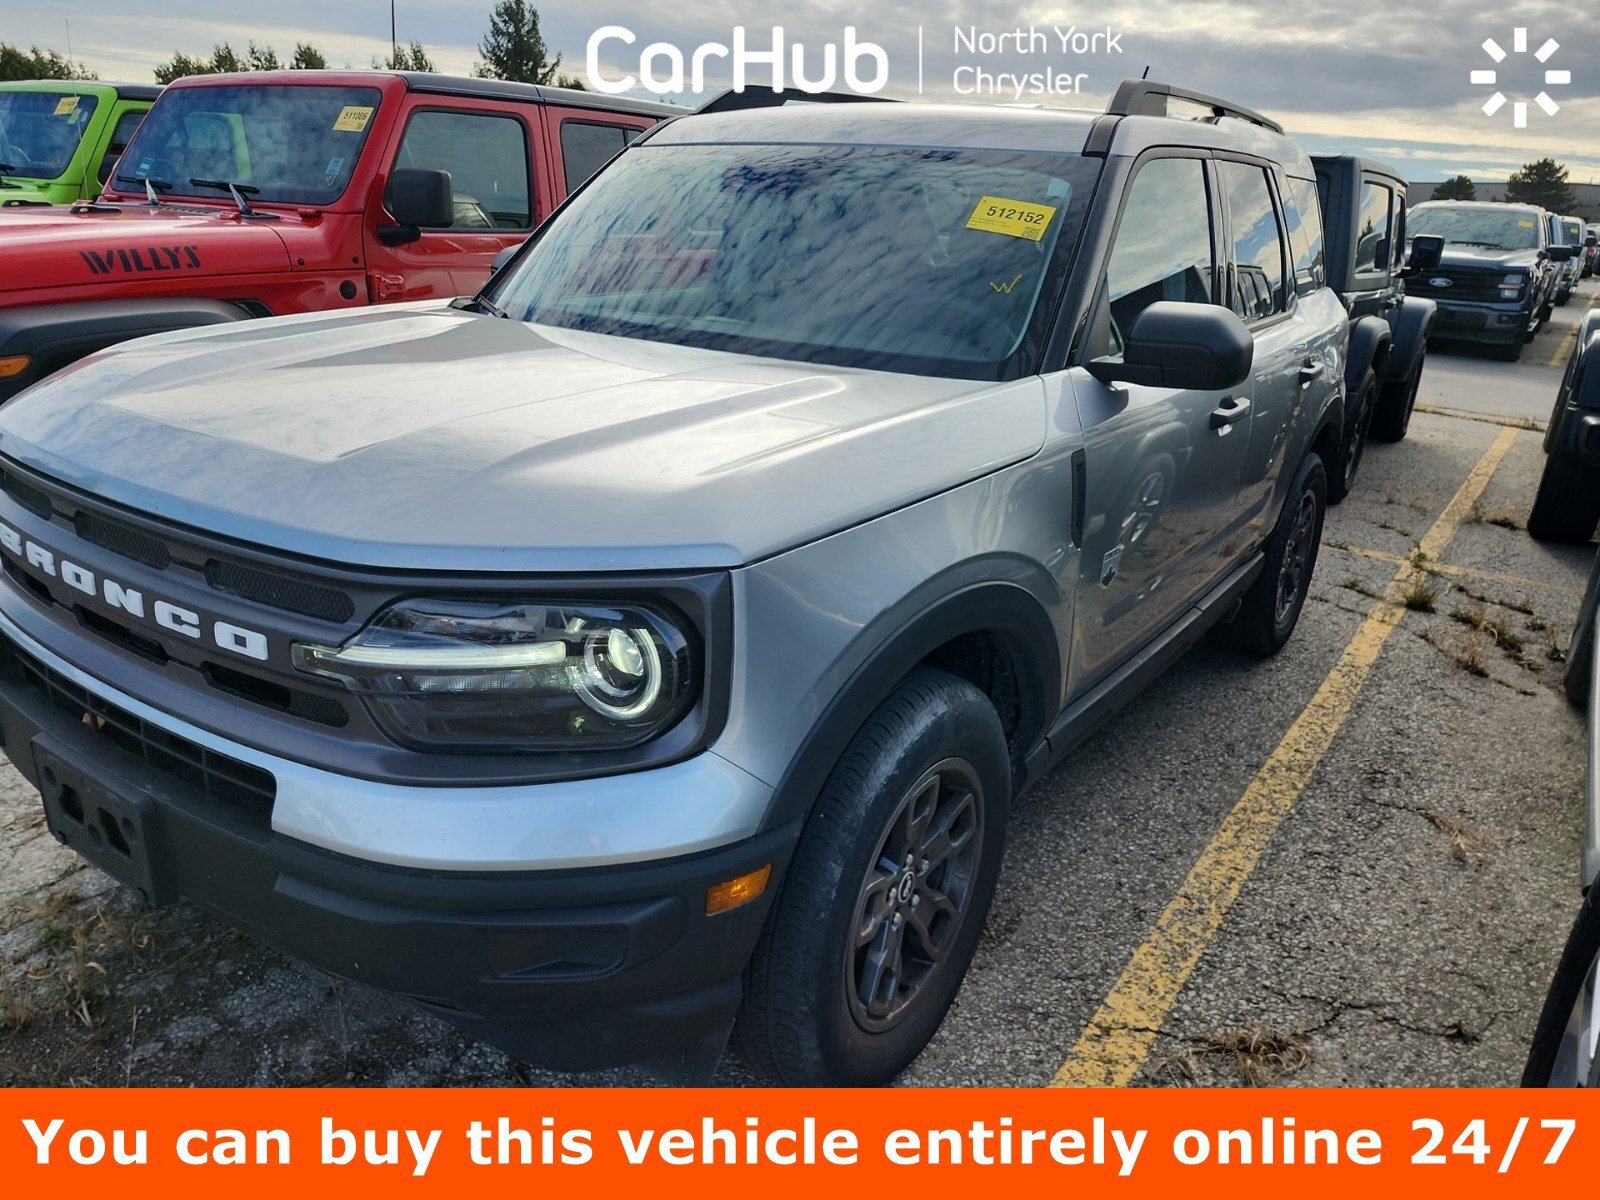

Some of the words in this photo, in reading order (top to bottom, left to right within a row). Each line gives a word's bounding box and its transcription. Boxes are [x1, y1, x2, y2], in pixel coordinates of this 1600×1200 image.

[986, 205, 1045, 225] 512152
[79, 245, 201, 275] WILLYS
[0, 521, 269, 662] BRONCO
